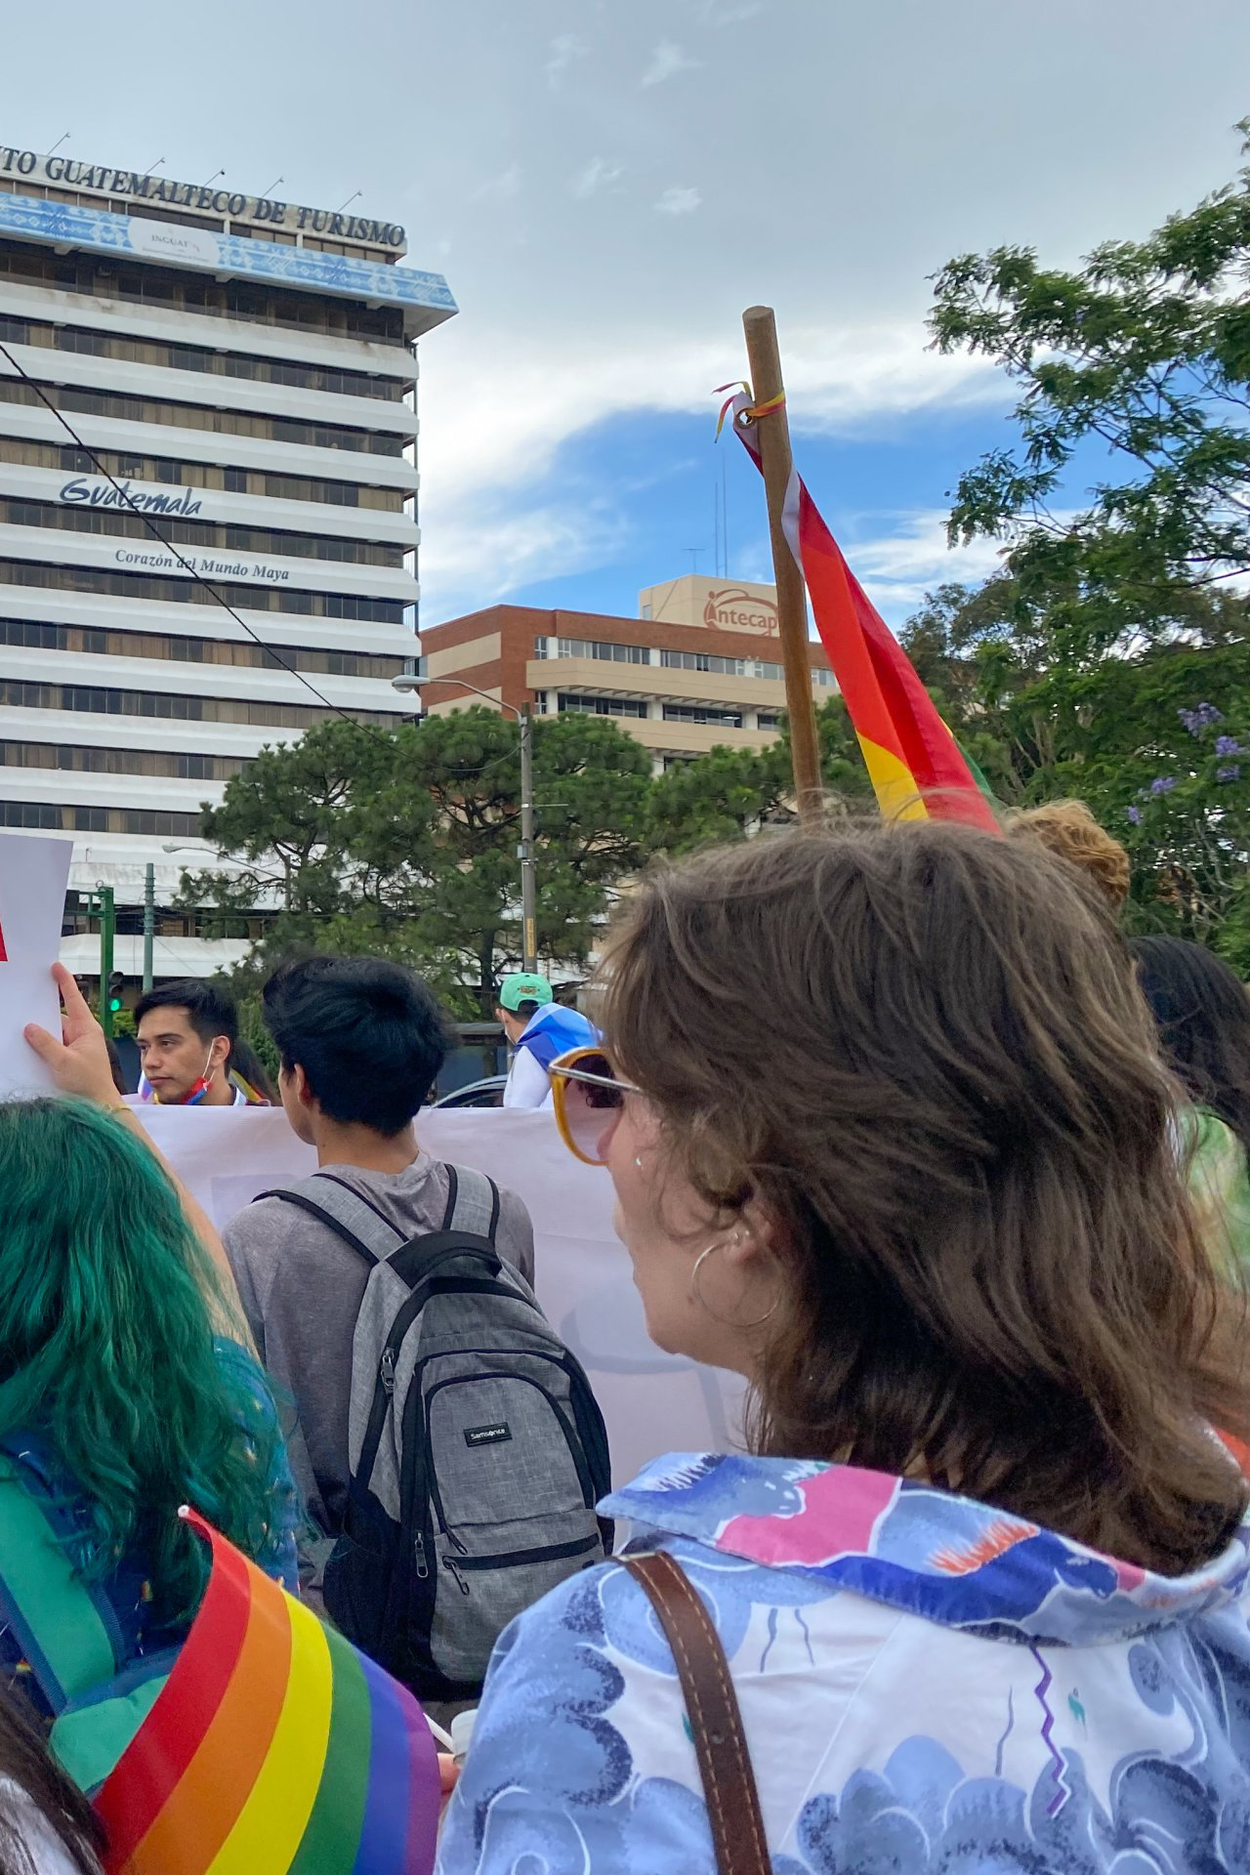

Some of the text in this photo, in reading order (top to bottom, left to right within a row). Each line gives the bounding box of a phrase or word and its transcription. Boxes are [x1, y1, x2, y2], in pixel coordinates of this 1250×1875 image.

[45, 157, 246, 216] GUATEMALTECO
[253, 198, 287, 224] DE
[296, 206, 406, 247] TURISMO
[151, 234, 188, 247] INGUAT
[59, 478, 203, 516] Guatemala
[115, 549, 290, 583] Corazón del Mundo Maya
[470, 1428, 506, 1440] Samsonite
